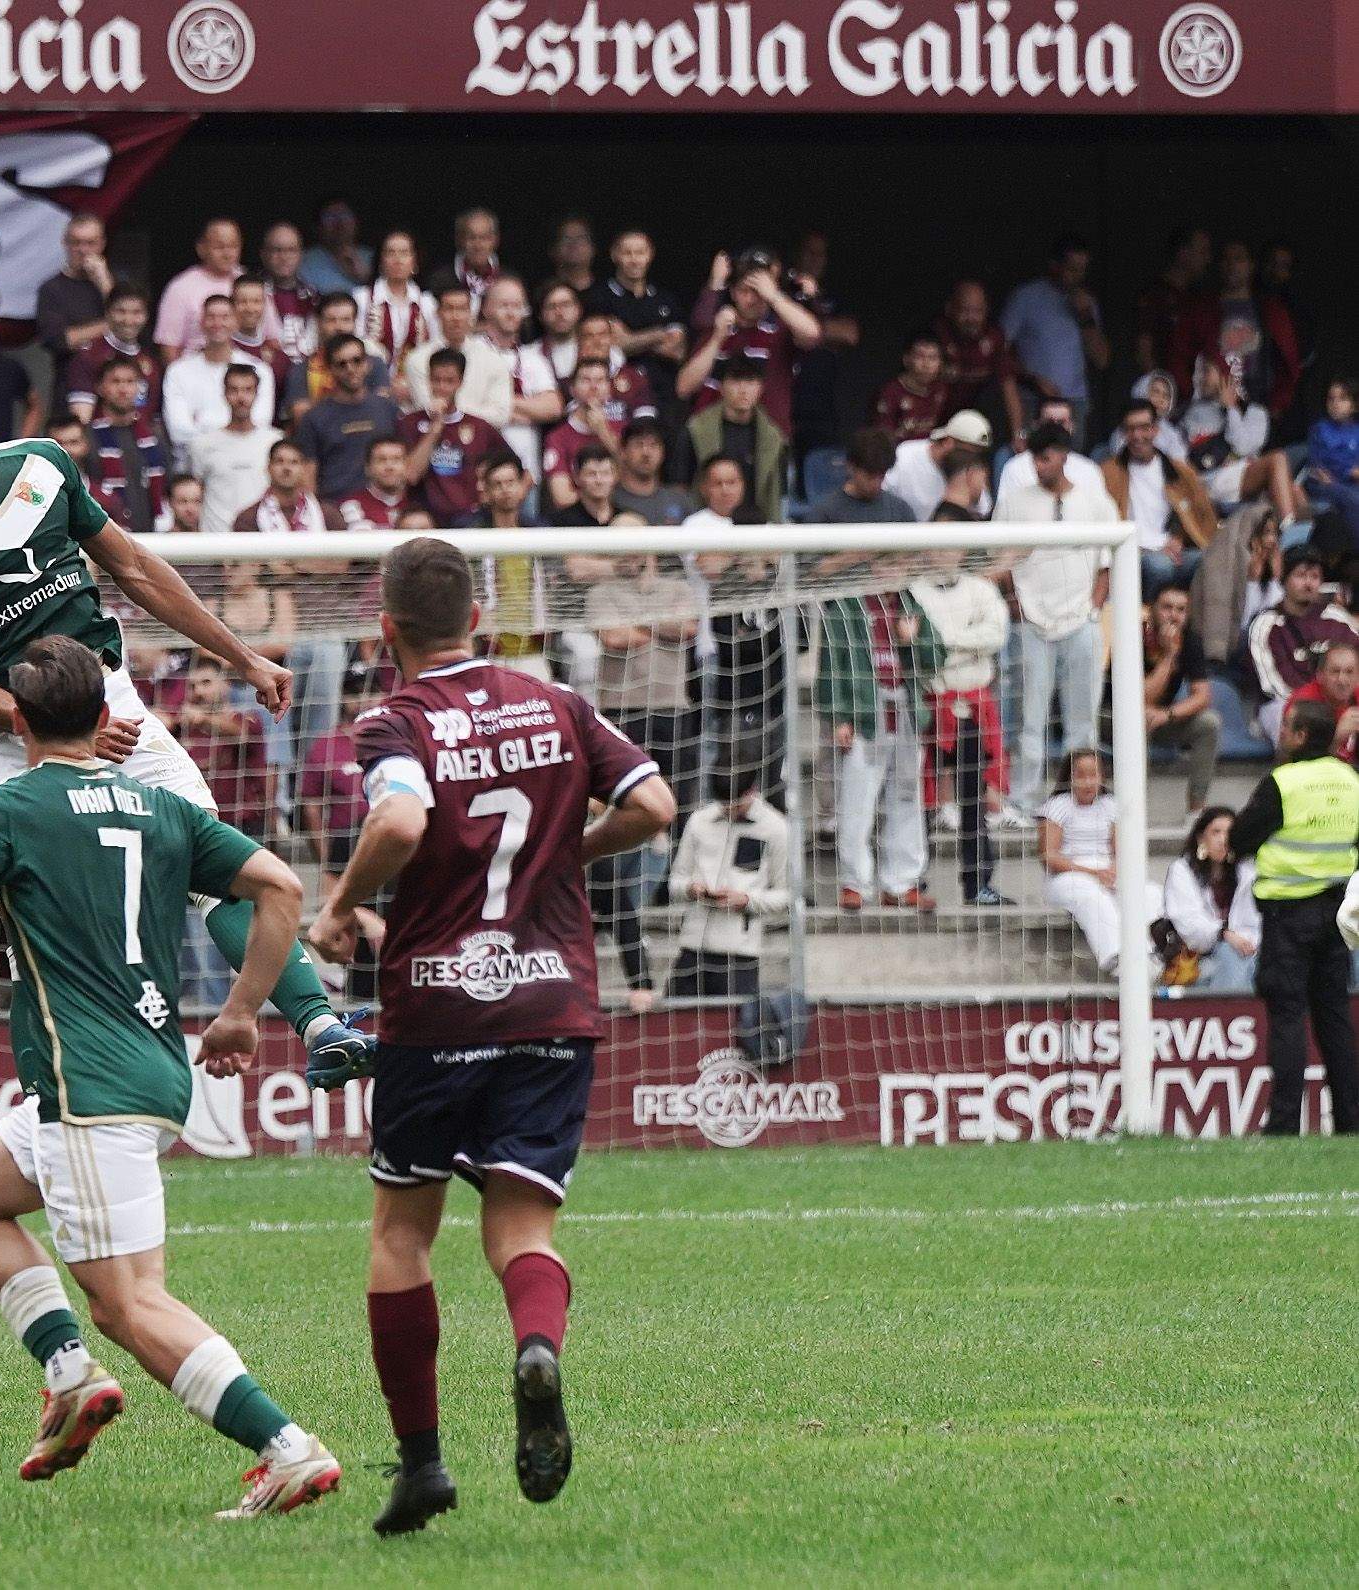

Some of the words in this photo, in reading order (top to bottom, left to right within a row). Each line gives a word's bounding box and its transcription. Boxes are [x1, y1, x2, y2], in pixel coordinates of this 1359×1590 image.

[464, 0, 811, 97] Estrella
[827, 0, 1138, 97] Galicia
[475, 712, 557, 736] Pontevedra
[435, 746, 499, 783] ALEX
[498, 730, 575, 774] GLEZ.
[66, 784, 115, 815] IVÁN
[467, 785, 534, 921] 7
[97, 826, 144, 965] 7
[411, 950, 572, 988] PESCAMAR
[1004, 1015, 1258, 1066] CONSRVAS
[257, 1070, 376, 1142] en
[633, 1081, 846, 1126] PESCAMAR
[880, 1066, 1336, 1147] PESCM
